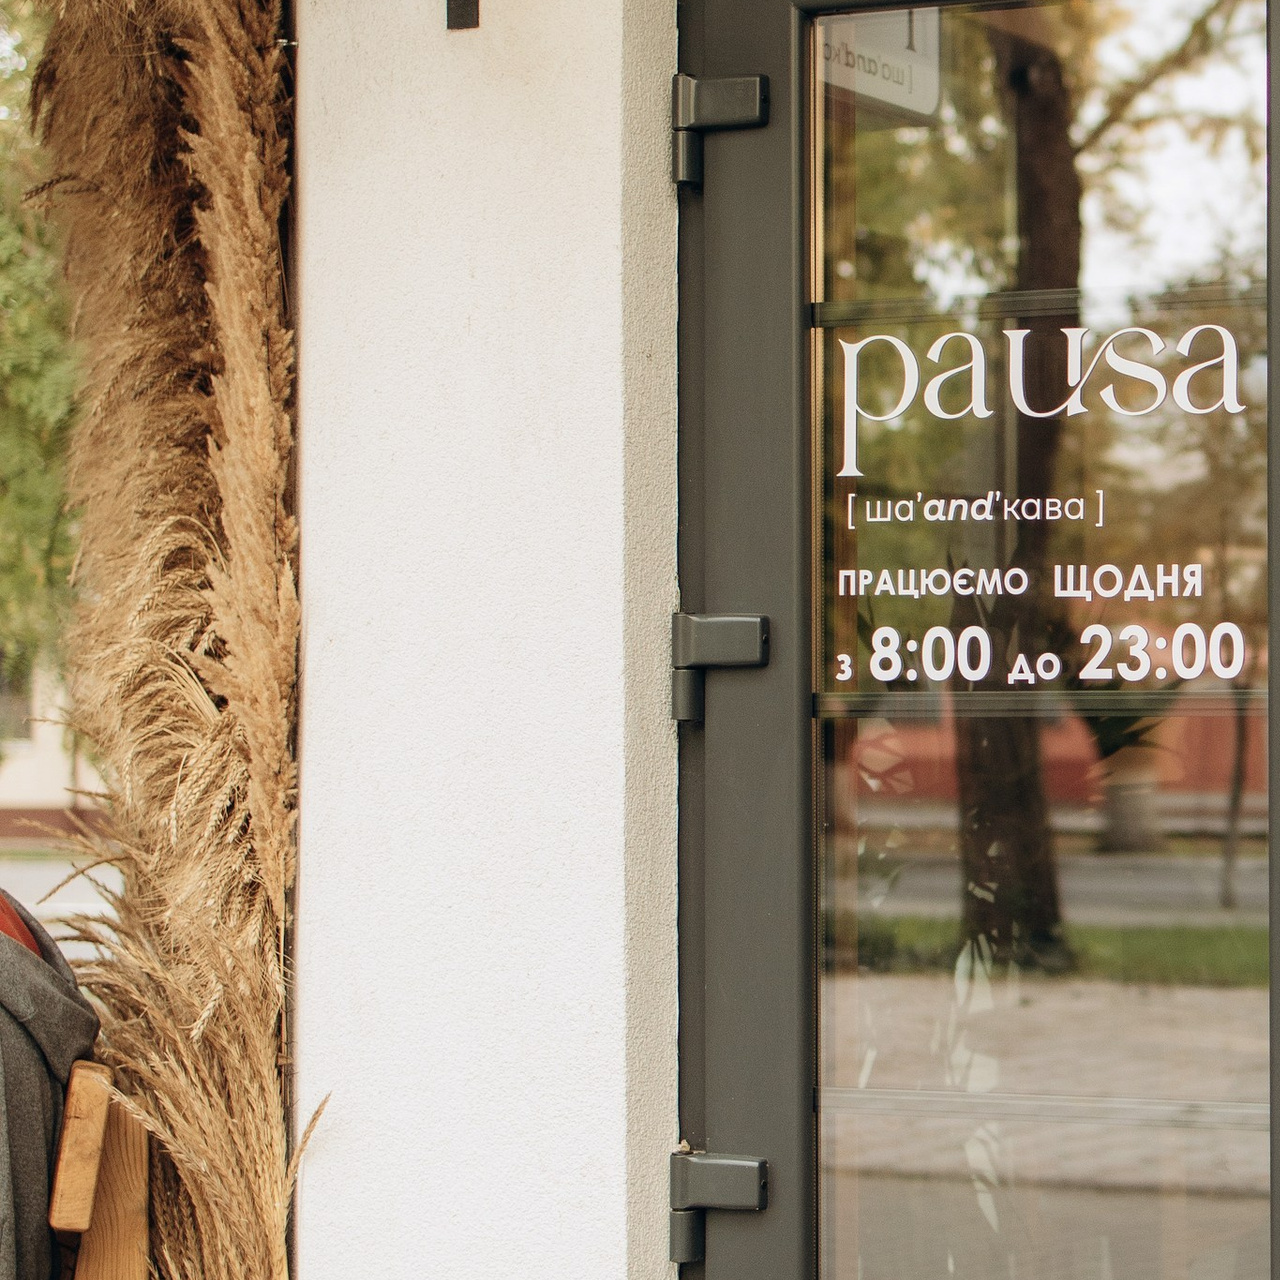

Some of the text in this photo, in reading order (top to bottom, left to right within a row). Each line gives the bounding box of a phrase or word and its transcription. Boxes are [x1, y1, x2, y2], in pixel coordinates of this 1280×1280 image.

[836, 324, 1247, 477] pausa
[838, 563, 1203, 602] ПРАЦЮЄМО ЩОДНЯ
[869, 625, 991, 681] 8:00
[1078, 622, 1245, 681] 23:00
